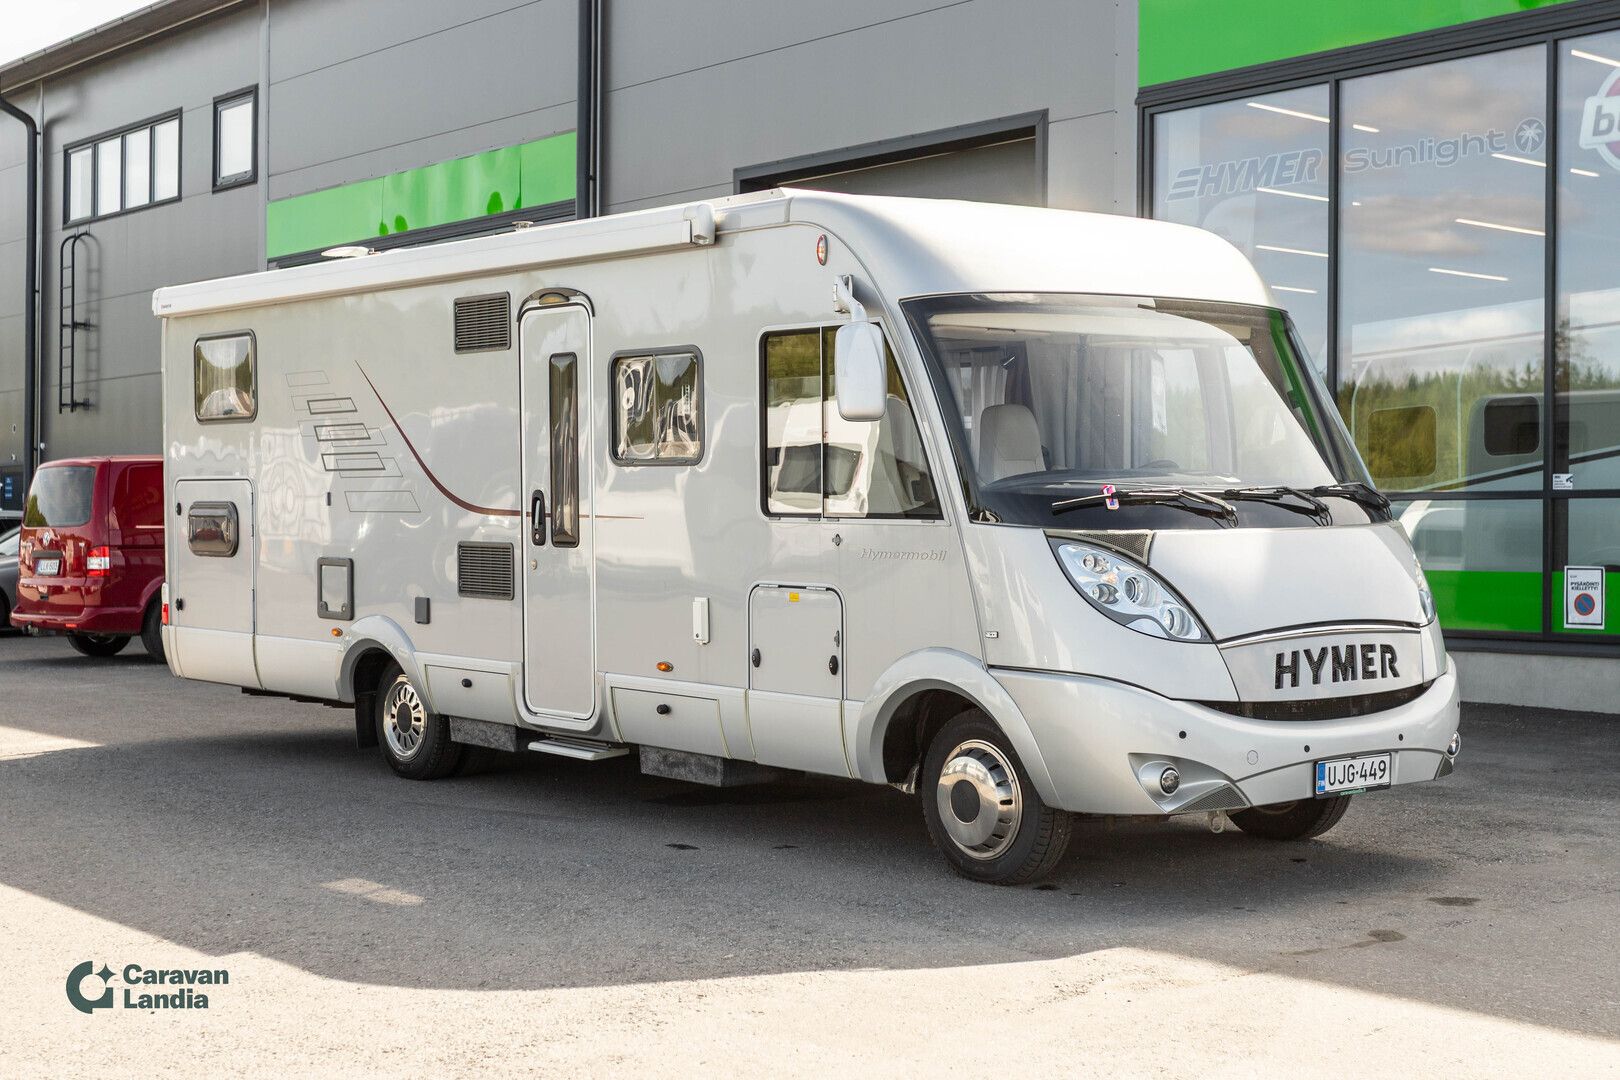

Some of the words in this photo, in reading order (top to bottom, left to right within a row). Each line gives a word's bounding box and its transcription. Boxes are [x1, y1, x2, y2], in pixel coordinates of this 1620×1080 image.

[1592, 105, 1620, 137] b
[1345, 130, 1506, 171] Sunlight
[1192, 148, 1323, 199] HYMER
[861, 548, 948, 561] Hymermobil
[1274, 643, 1400, 690] HYMER
[1328, 759, 1387, 786] UJG-449
